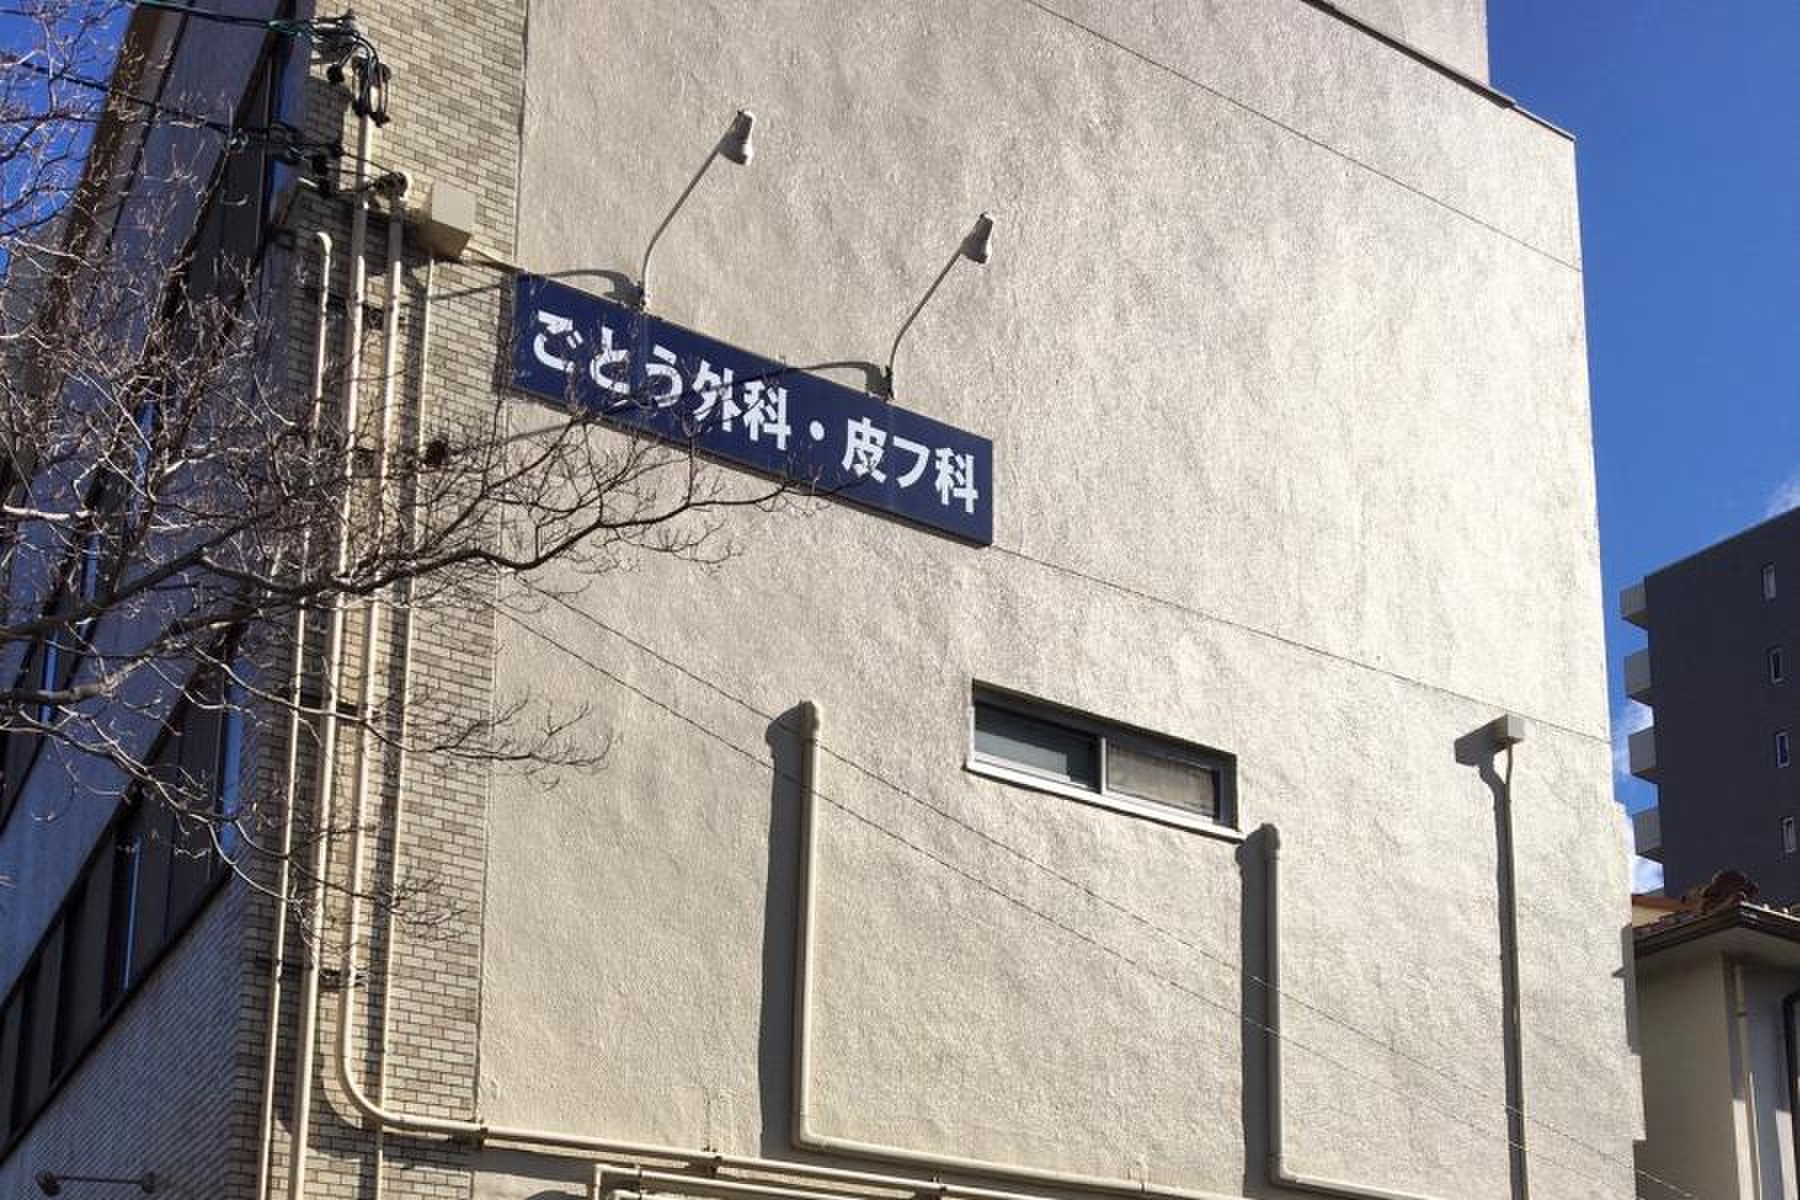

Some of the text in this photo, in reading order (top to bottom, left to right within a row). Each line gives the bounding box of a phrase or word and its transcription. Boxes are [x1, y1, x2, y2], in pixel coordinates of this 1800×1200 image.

[533, 311, 979, 513] ごとう外科・皮フ科
